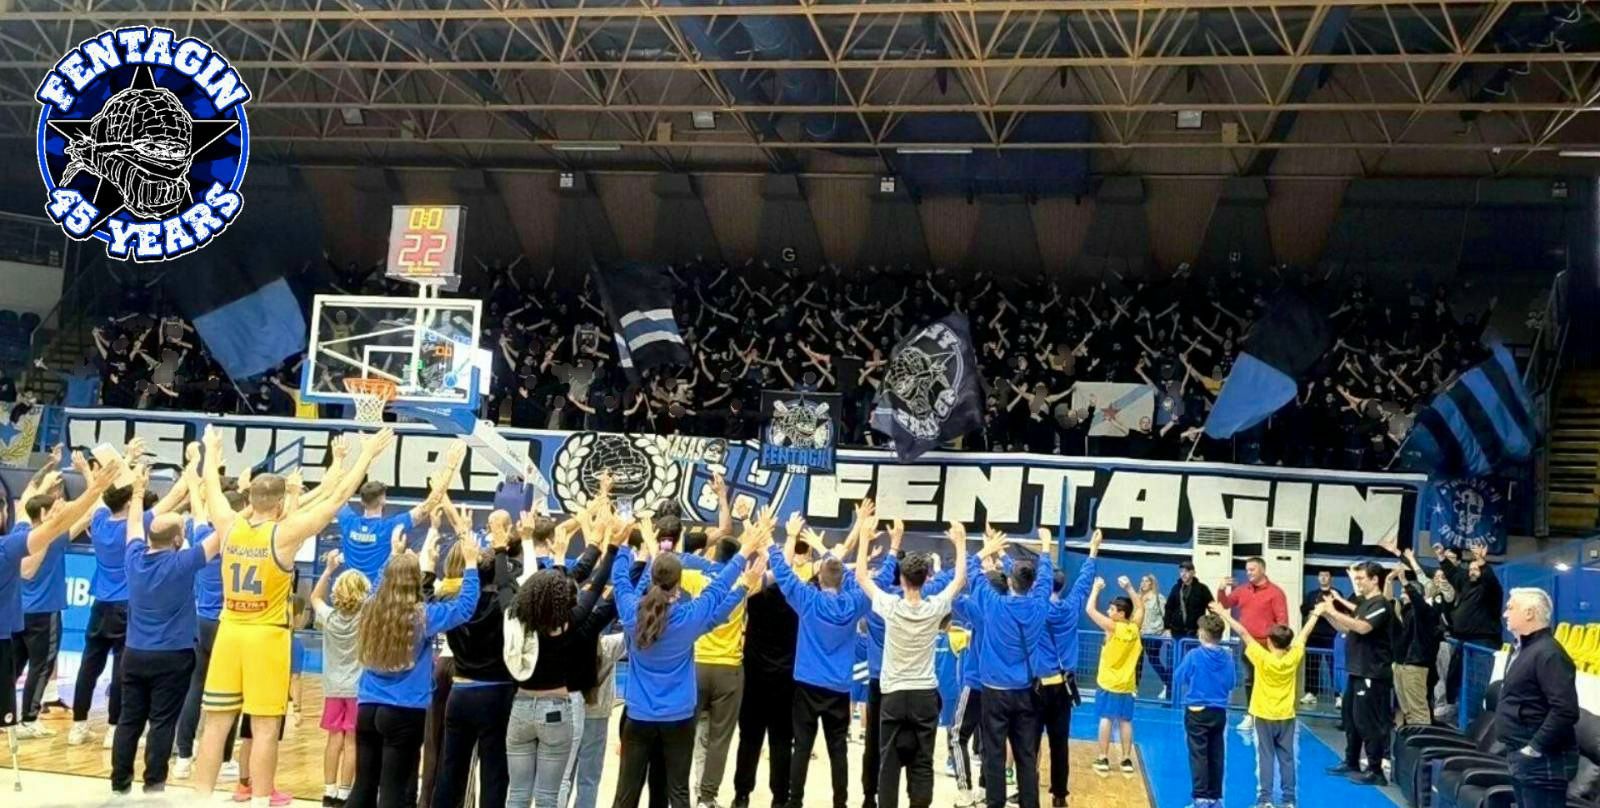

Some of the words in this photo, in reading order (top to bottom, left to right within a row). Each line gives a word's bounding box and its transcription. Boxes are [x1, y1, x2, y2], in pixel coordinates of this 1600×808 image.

[782, 247, 796, 262] G
[761, 443, 834, 470] FENTAGIN
[807, 464, 1404, 546] FENTAGIN
[229, 562, 262, 594] 14
